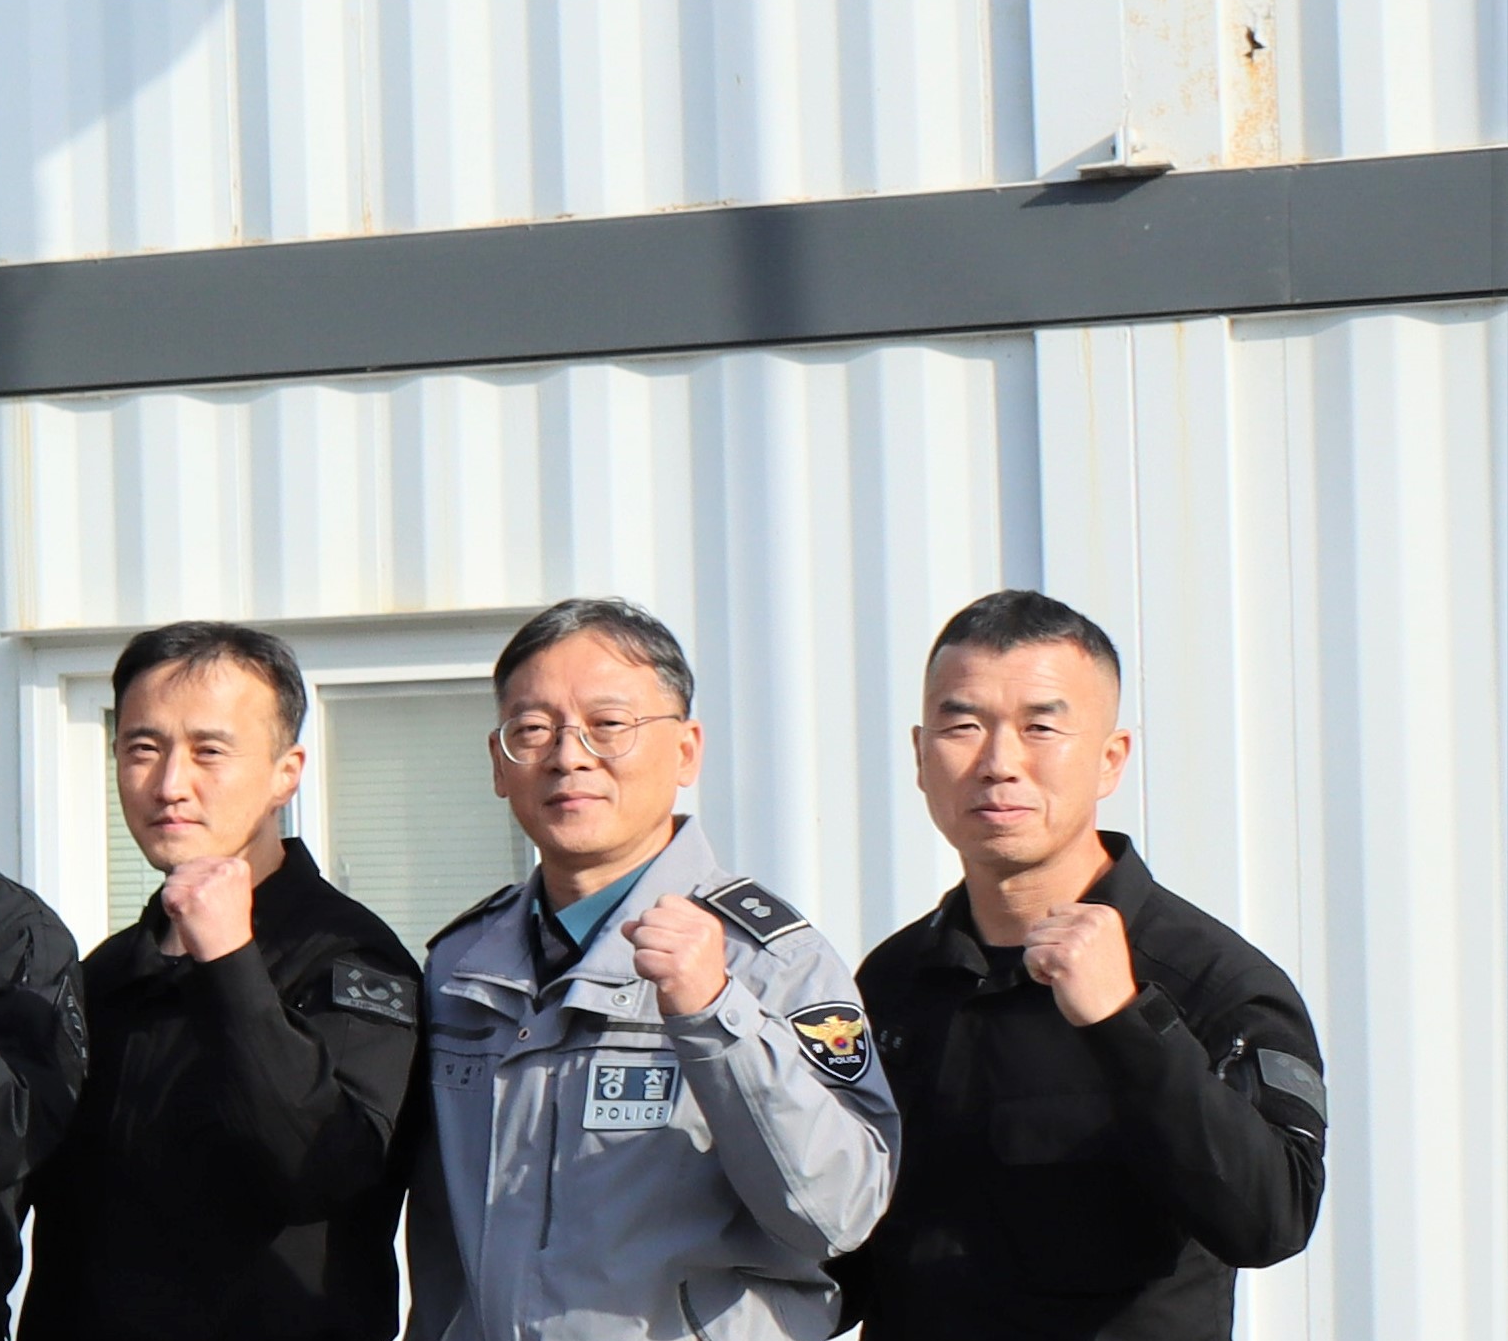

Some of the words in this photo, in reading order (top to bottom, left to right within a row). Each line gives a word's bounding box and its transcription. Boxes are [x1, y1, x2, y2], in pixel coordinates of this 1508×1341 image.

[827, 1054, 862, 1066] POLICE
[599, 1067, 671, 1100] 경찰
[595, 1106, 664, 1121] POLICE
